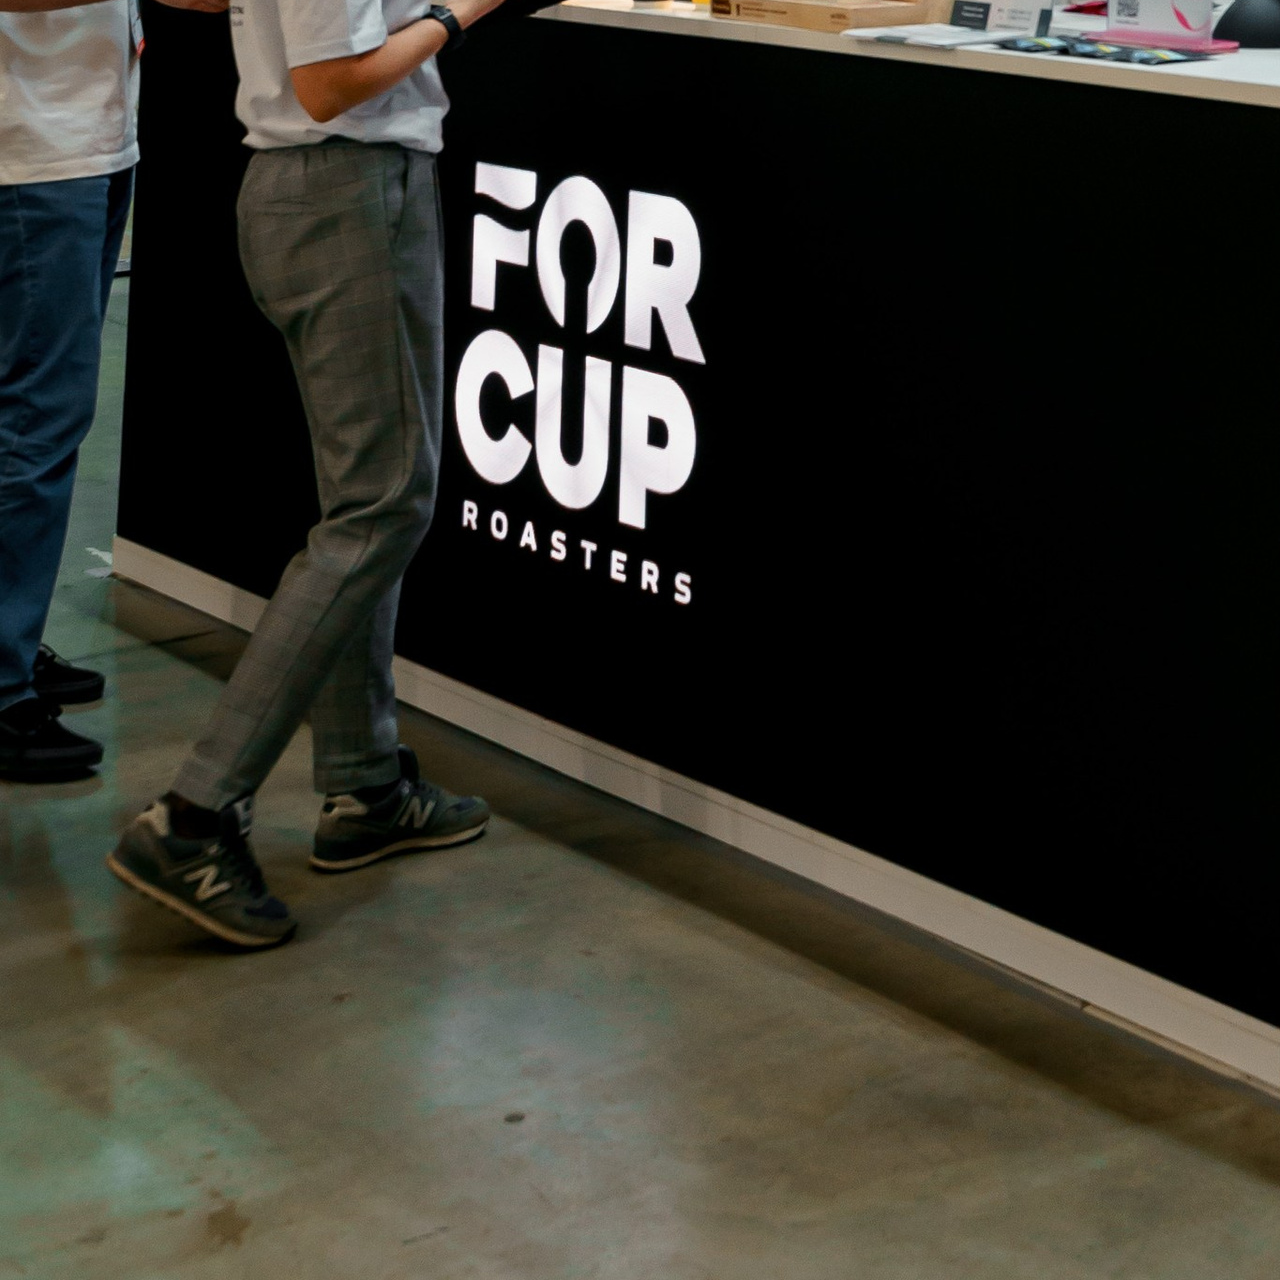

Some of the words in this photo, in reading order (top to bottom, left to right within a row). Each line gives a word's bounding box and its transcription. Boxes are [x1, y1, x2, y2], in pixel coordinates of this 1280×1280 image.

[471, 161, 706, 365] FOR
[454, 329, 697, 529] CUP
[462, 499, 692, 605] ROASTERS
